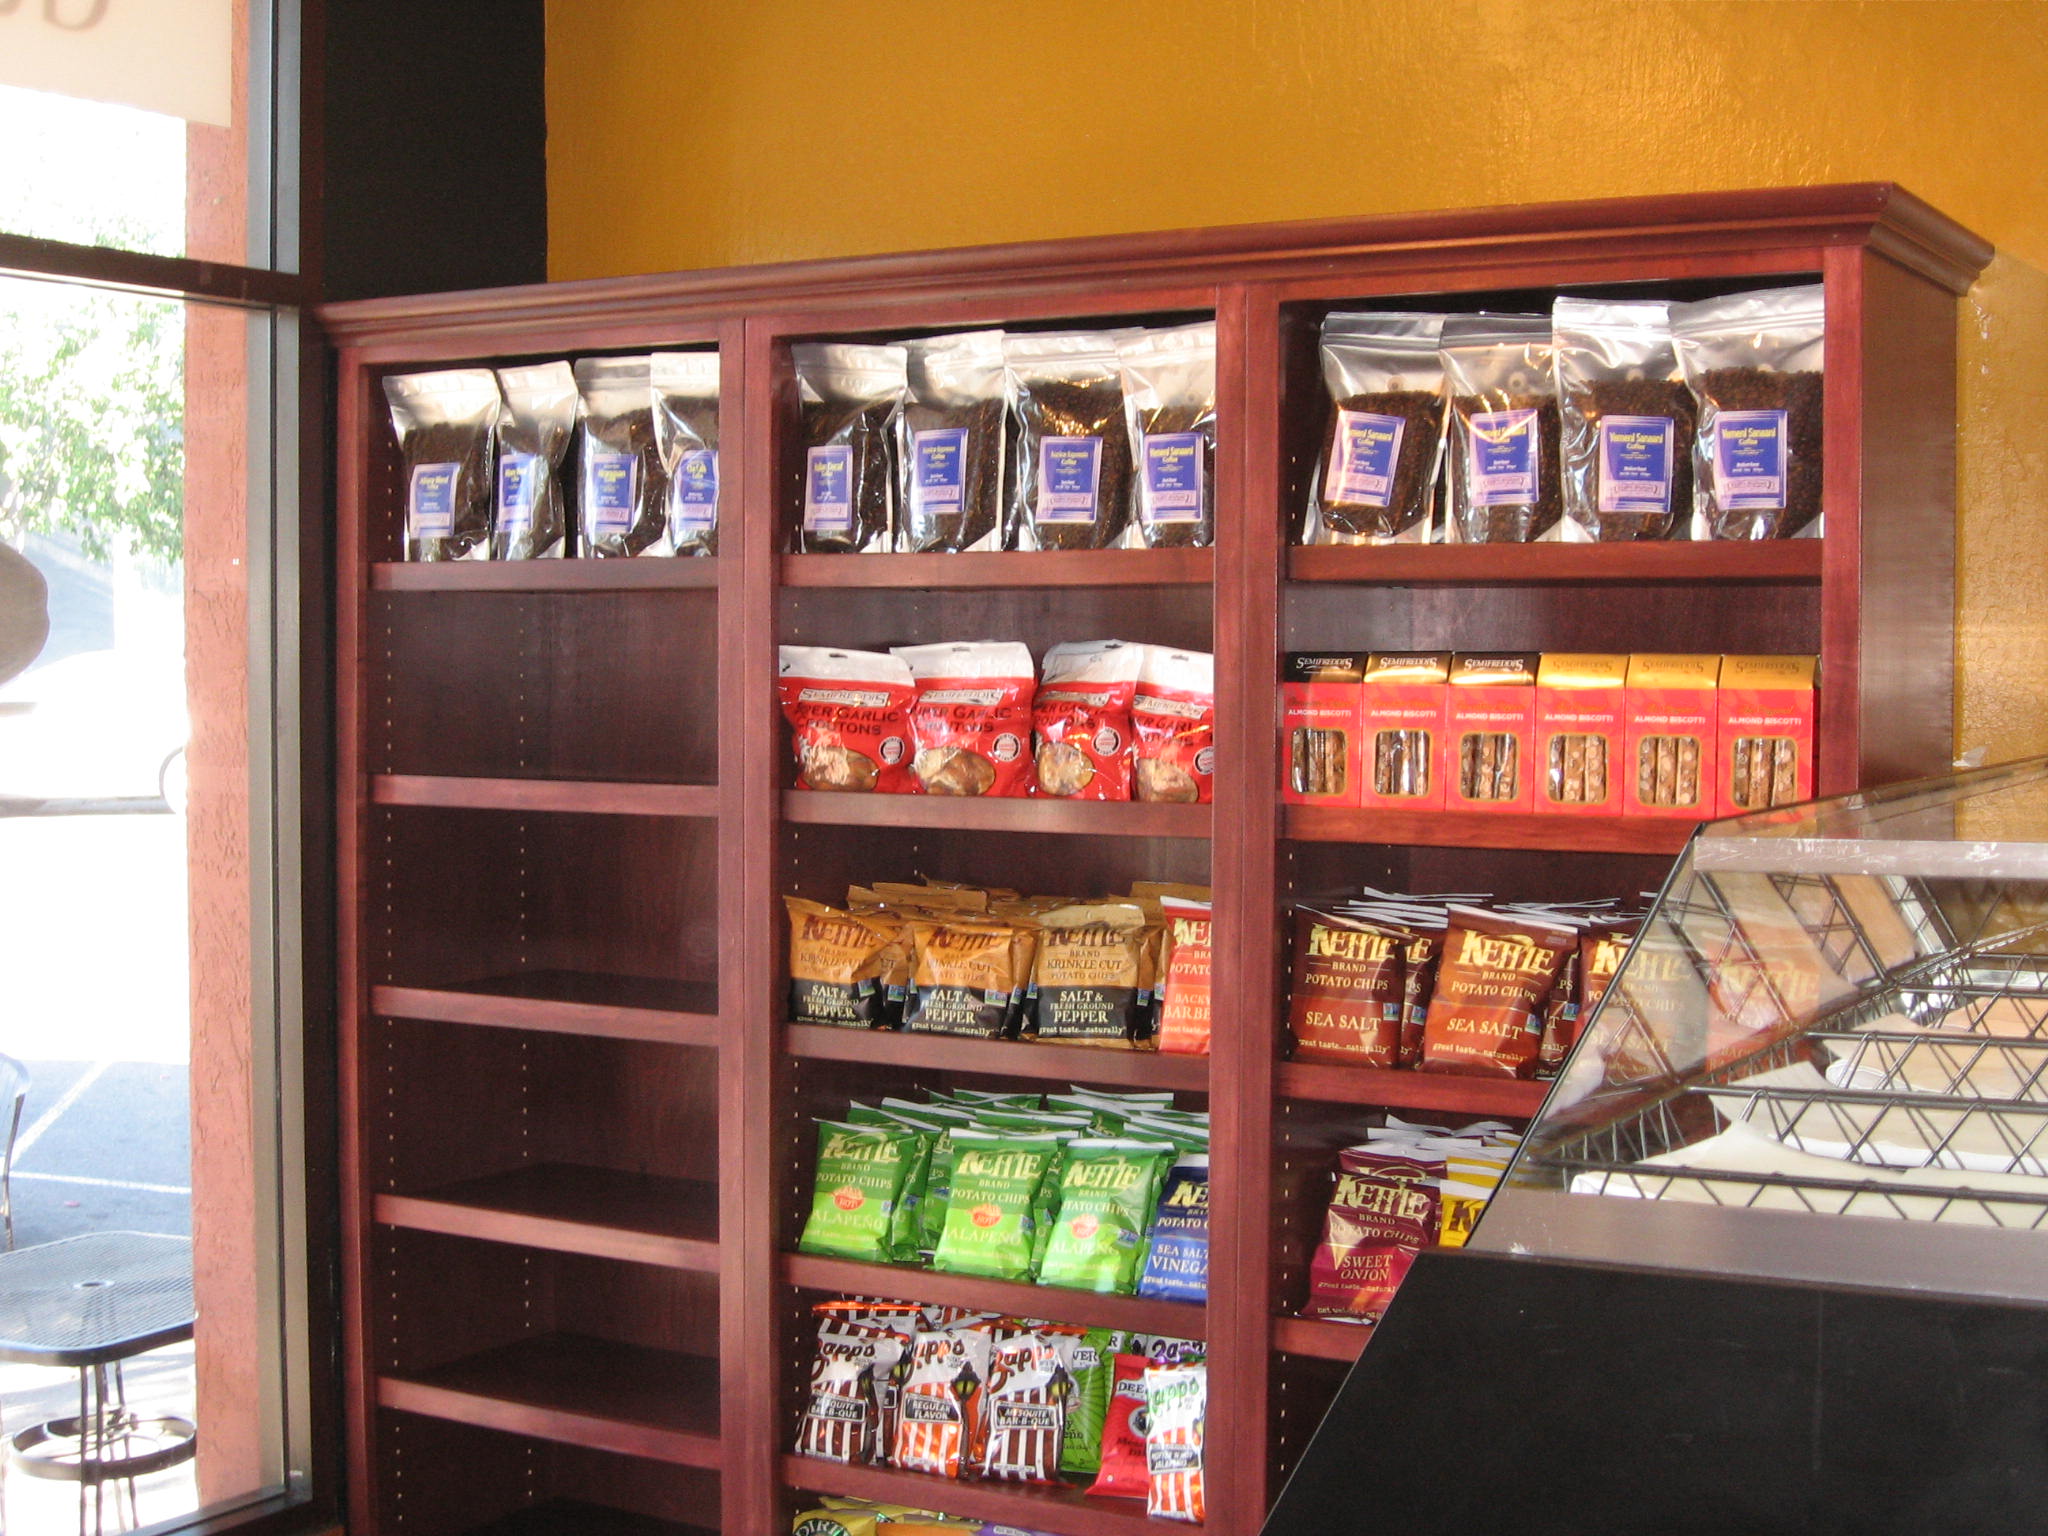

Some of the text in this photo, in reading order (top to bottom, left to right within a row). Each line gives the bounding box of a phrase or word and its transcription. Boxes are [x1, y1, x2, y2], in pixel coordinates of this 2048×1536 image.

[838, 707, 900, 722] GARLIC
[1288, 709, 1351, 718] ALMOND BISCOTTI
[1371, 710, 1437, 719] ALMOND BISCOTTI
[1456, 712, 1523, 722] ALMOND BISCOTTI
[1545, 714, 1614, 724] ALMOND BISCOTTI
[1635, 715, 1705, 725] ALMOND BISCOTTI
[1728, 717, 1802, 726] ALMOND BISCOTTI
[1305, 923, 1399, 963] KETTLE
[1069, 950, 1101, 958] BRAND
[1194, 951, 1211, 959] BRA
[1454, 929, 1555, 978] KETTLE
[969, 961, 993, 974] CUT
[1048, 959, 1122, 971] KRINKLE CUT
[1332, 962, 1367, 973] BRAND
[1588, 940, 1692, 983] KTTLE
[1052, 972, 1086, 981] POTATO
[1305, 973, 1351, 989] POTATO
[1353, 979, 1390, 992] CHIPS
[1481, 970, 1516, 982] BRAND
[812, 984, 842, 998] SALT
[930, 989, 963, 1002] SALT
[1060, 990, 1104, 1002] SALT &
[1451, 981, 1537, 1004] POTATO CHIPS
[827, 996, 860, 1008] GROUND
[1175, 992, 1211, 1006] BACKY
[808, 1002, 857, 1020] PEPPER
[947, 1003, 983, 1013] GROUND
[1050, 1002, 1114, 1012] FRESH GROUND
[1163, 1005, 1210, 1020] BARBE
[925, 1008, 976, 1024] PEPPER
[1054, 1010, 1113, 1024] PEPPER
[1306, 1010, 1382, 1032] SEA SALT
[1446, 1018, 1523, 1040] SEA SALT
[820, 1132, 902, 1163] KETTLE
[841, 1163, 871, 1172] BRAND
[955, 1149, 1042, 1180] KETTLE
[1063, 1156, 1142, 1190] KETTLE
[816, 1172, 893, 1190] POTATO CHIPS
[979, 1179, 1011, 1189] BRAND
[952, 1189, 1031, 1205] POTATO CHIPS
[1329, 1173, 1431, 1220] KETTLE
[1062, 1200, 1094, 1211] OTATO
[1158, 1216, 1201, 1229] POTATO
[1359, 1212, 1396, 1226] BRAND
[1331, 1222, 1420, 1245] POTATO CHIPS
[1157, 1243, 1179, 1257] SEA
[1152, 1255, 1208, 1275] VINEG
[1343, 1254, 1394, 1269] SWEET
[1340, 1269, 1389, 1281] ONION
[1073, 1350, 1099, 1363] VER
[1118, 1381, 1145, 1395] DEE
[914, 1410, 949, 1421] FLAVOR
